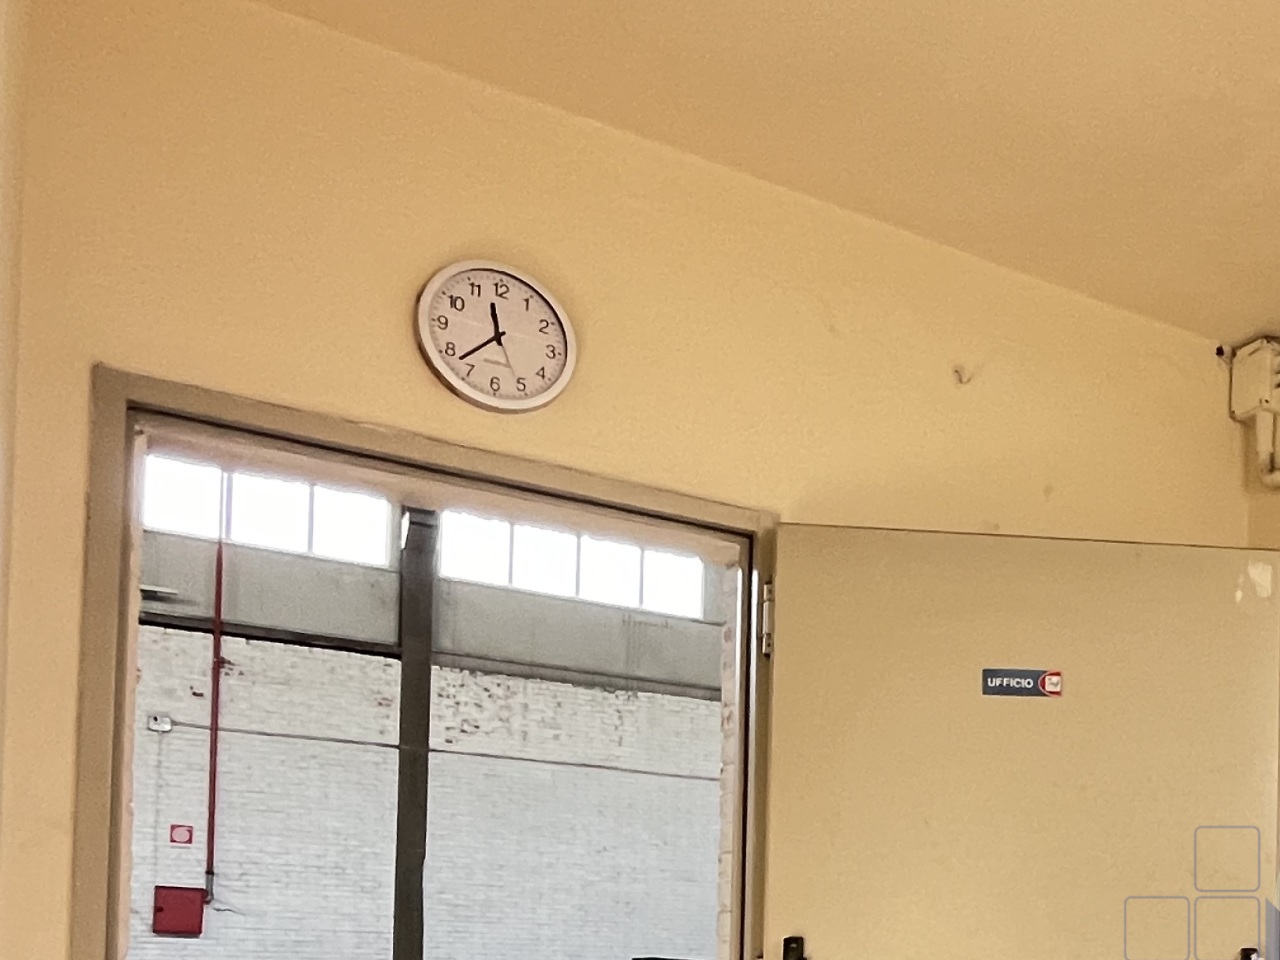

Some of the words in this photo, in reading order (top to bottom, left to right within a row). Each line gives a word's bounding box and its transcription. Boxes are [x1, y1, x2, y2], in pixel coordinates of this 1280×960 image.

[469, 282, 482, 297] 11
[492, 282, 510, 299] 12
[448, 295, 465, 312] 10
[523, 298, 531, 312] 1
[437, 315, 449, 330] 9
[538, 319, 549, 334] 2
[444, 342, 456, 357] 8
[545, 345, 556, 359] 3
[465, 363, 476, 377] 7
[535, 366, 546, 380] 4
[489, 376, 501, 392] 6
[516, 377, 527, 392] 5
[987, 676, 1034, 689] UFFICIO
